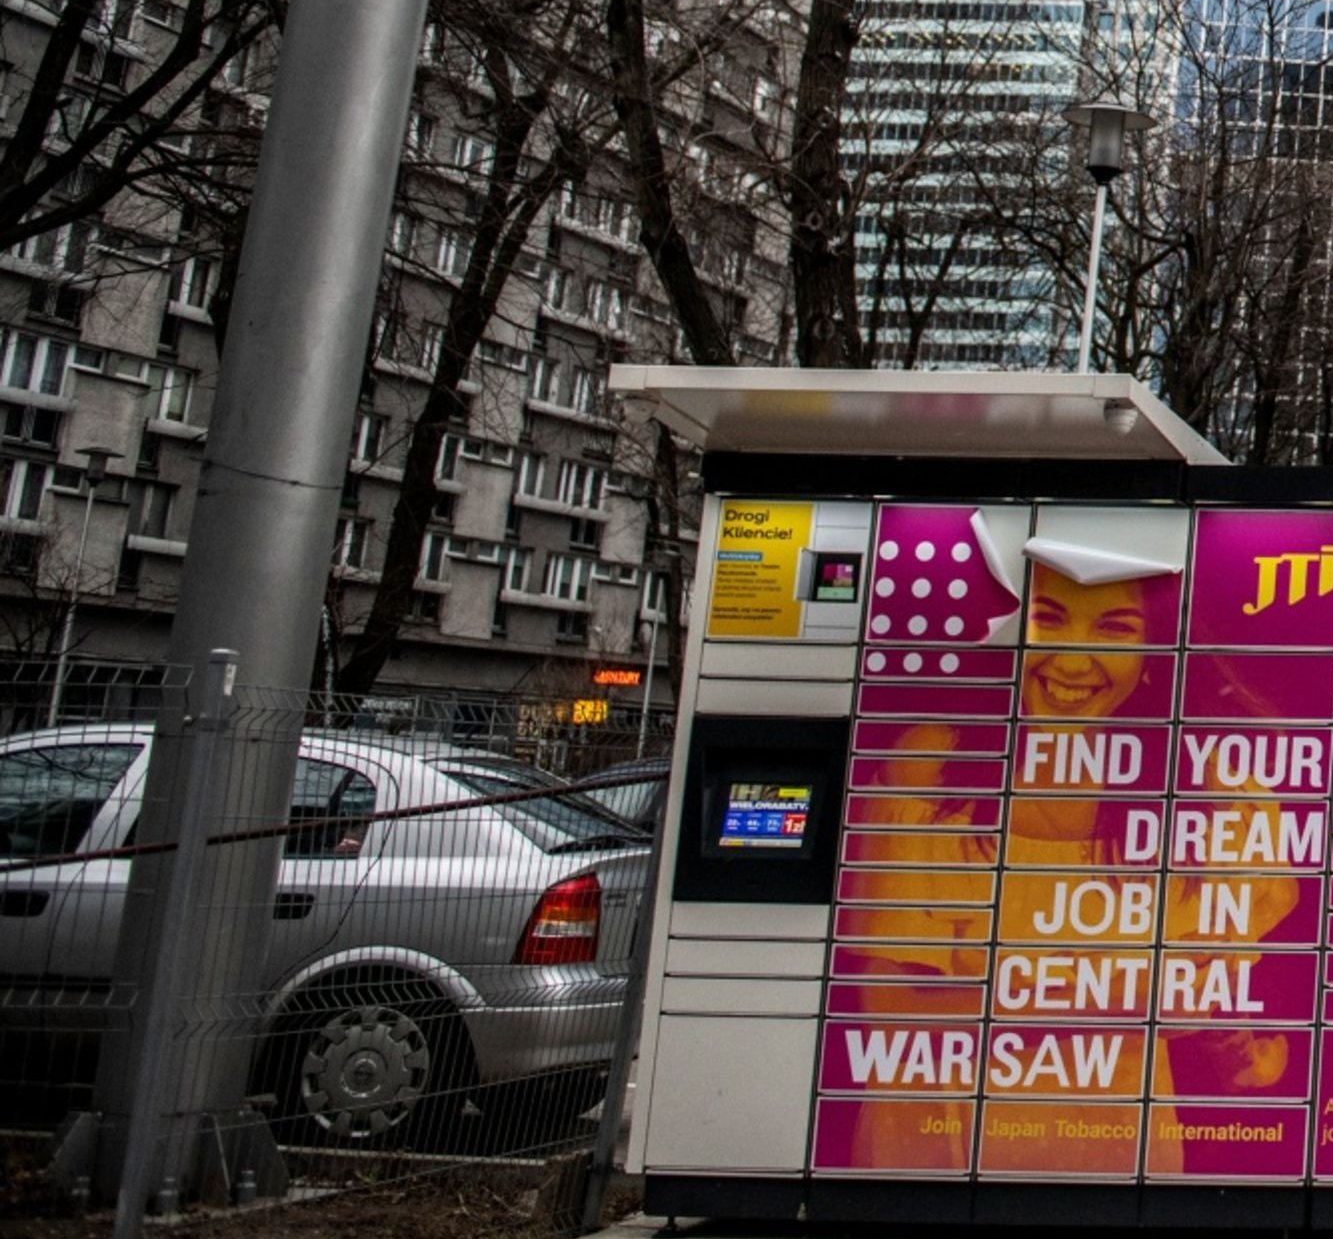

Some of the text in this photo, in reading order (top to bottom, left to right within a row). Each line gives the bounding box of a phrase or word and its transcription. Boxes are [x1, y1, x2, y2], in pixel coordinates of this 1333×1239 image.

[722, 527, 793, 540] Kliencie!
[724, 509, 770, 524] Drogi
[1022, 732, 1323, 787] FIND YOUR
[1124, 810, 1324, 863] DREAM
[1033, 881, 1251, 936] JOB IN
[996, 954, 1264, 1013] CENTRAL
[844, 1029, 1123, 1088] WARSAW
[920, 1115, 1284, 1142] Join Japan Tobacco International
